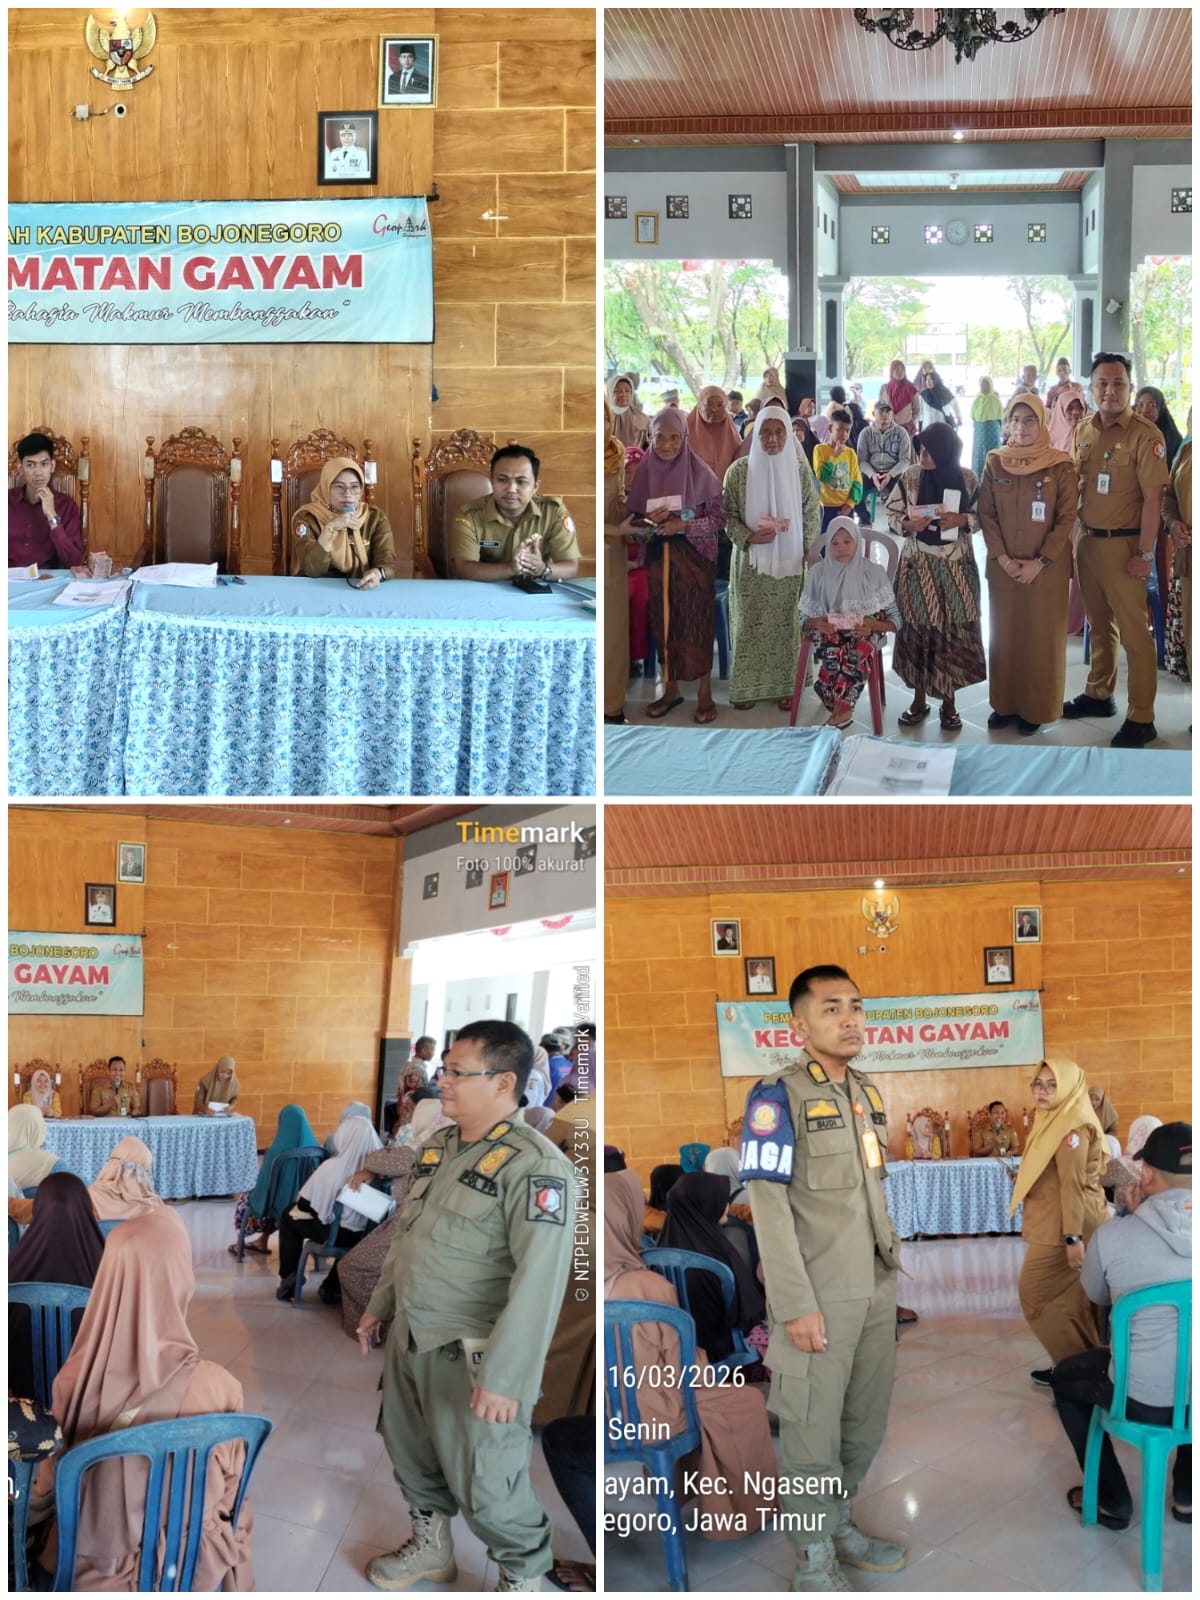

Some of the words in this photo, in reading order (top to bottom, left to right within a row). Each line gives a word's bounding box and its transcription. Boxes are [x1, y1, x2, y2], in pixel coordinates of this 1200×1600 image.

[36, 225, 171, 244] KABUPATEN
[177, 223, 342, 244] BOJONEGORO
[8, 256, 171, 290] MATAN
[183, 254, 363, 290] GAYAM
[83, 301, 174, 323] Makmur
[177, 301, 339, 327] Membanggakan
[10, 944, 98, 959] BOJONEGORO
[14, 963, 109, 985] GAYAM
[915, 1003, 999, 1018] BOJONEGORO
[919, 1020, 1010, 1043] GAYAM
[816, 1120, 838, 1129] BUDI
